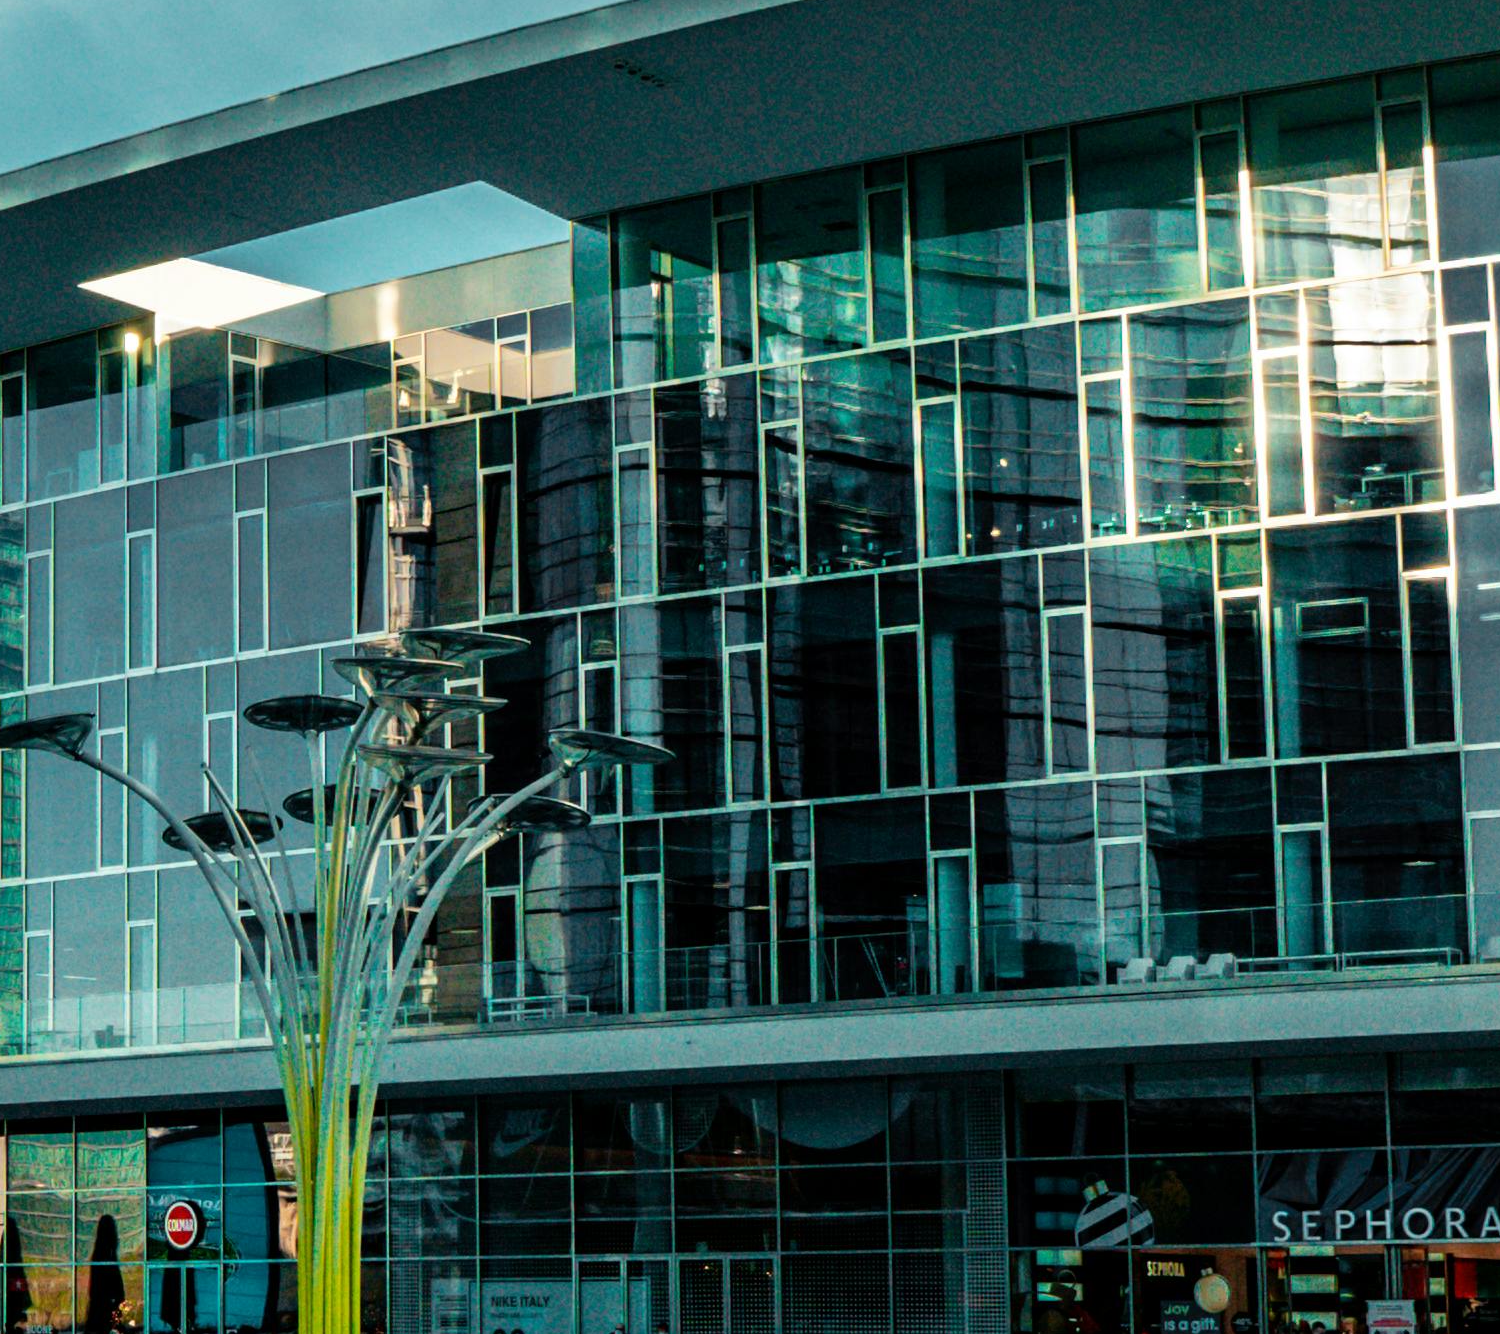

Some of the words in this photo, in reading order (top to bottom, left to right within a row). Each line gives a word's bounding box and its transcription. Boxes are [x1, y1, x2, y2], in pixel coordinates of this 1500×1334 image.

[167, 1218, 194, 1232] COLMAR
[1146, 1260, 1186, 1278] SEPHORA
[491, 1296, 517, 1308] NIKE
[519, 1295, 550, 1308] ITALY
[1164, 1319, 1176, 1331] is
[1178, 1319, 1189, 1331] a
[1190, 1317, 1220, 1334] gift.
